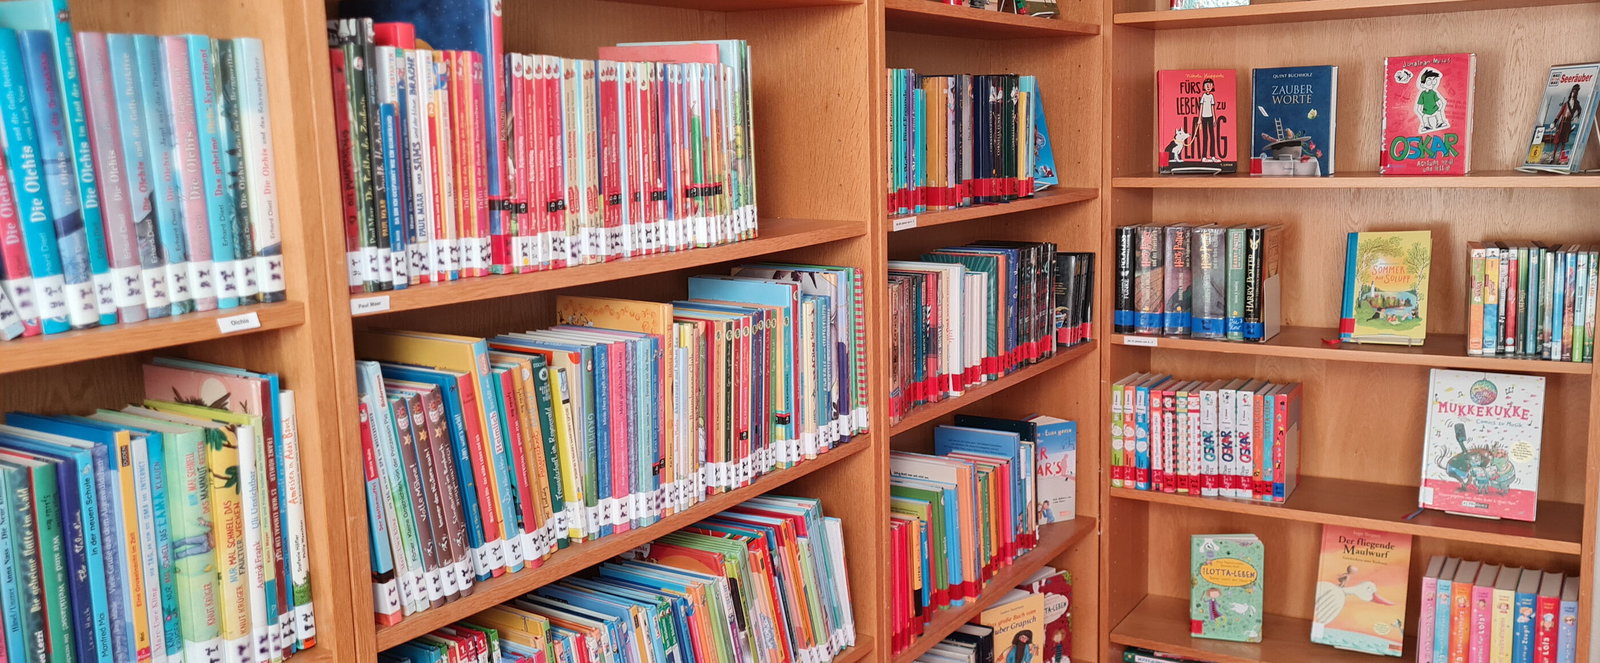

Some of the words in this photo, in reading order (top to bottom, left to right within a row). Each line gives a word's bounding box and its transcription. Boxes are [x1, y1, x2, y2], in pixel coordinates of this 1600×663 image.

[1180, 80, 1200, 94] FÜRS
[1272, 85, 1313, 95] ZAUBER
[1560, 73, 1593, 83] Seeräuber
[1177, 99, 1200, 115] LEBEN
[1217, 102, 1226, 110] ZU
[1272, 94, 1312, 105] WORTE
[184, 130, 198, 173] Olchis
[208, 138, 221, 174] geheime
[412, 141, 422, 171] SAMS
[1390, 133, 1459, 161] OSKAR
[20, 146, 42, 193] Olchis
[78, 142, 94, 183] Olchis
[107, 149, 119, 182] Olchis
[161, 152, 172, 182] Olchis
[260, 148, 270, 176] Olchis
[137, 161, 148, 193] Olchis
[212, 177, 224, 196] Das
[236, 160, 246, 190] Olchis
[84, 188, 98, 208] Die
[112, 186, 122, 201] Die
[188, 177, 201, 201] Die
[262, 180, 272, 195] Die
[28, 198, 46, 222] Die
[217, 204, 226, 220] Dietl
[240, 194, 248, 208] Die
[416, 193, 424, 215] MAAR
[4, 222, 20, 244] Die
[145, 218, 155, 237] Dietl
[172, 227, 181, 251] Erhard
[219, 220, 228, 246] Erhard
[418, 218, 426, 237] PAUL
[148, 238, 158, 264] Erhard
[1172, 231, 1184, 250] Potter
[1174, 251, 1184, 267] Harry
[1372, 266, 1406, 275] SOMMER
[1246, 285, 1254, 312] HARRY
[1438, 401, 1530, 420] MUKKEKUKKE
[491, 413, 502, 452] Heimlich
[1203, 430, 1216, 462] OSKAR
[1221, 430, 1233, 463] OSKAR
[1239, 431, 1251, 464] OSKAR
[154, 461, 162, 490] KLAUEN
[185, 452, 195, 477] SCHNELL
[82, 477, 92, 505] Schule
[187, 479, 196, 491] MAL
[197, 465, 208, 500] MAMMUT
[249, 471, 258, 514] Unsichtbar
[287, 470, 299, 504] Ameisen
[87, 507, 95, 530] neuen
[224, 500, 232, 514] DAS
[22, 514, 33, 527] im
[233, 502, 243, 538] WECKEN
[88, 533, 97, 545] der
[226, 517, 235, 548] SCHNELL
[1338, 536, 1355, 545] Der
[1356, 537, 1395, 551] fliegende
[161, 543, 170, 569] SCHNELL
[228, 550, 236, 565] MAL
[236, 539, 246, 575] FAULTIER
[253, 540, 262, 564] Frank
[1343, 544, 1389, 559] Maulwurf
[28, 558, 41, 595] geheime
[229, 566, 238, 584] NUR
[255, 565, 264, 589] Astrid
[54, 553, 62, 571] sind
[59, 583, 68, 630] Weltklasse!
[203, 581, 213, 606] KRÜGER
[235, 584, 245, 613] KRÜGER
[30, 598, 41, 613] Die
[206, 607, 215, 626] KNUT
[1044, 602, 1066, 614] TA-LEBEN
[238, 614, 246, 634] KNUT
[1011, 616, 1036, 630] Grapsch
[34, 630, 45, 653] Lozzi
[101, 627, 110, 658] Manfred
